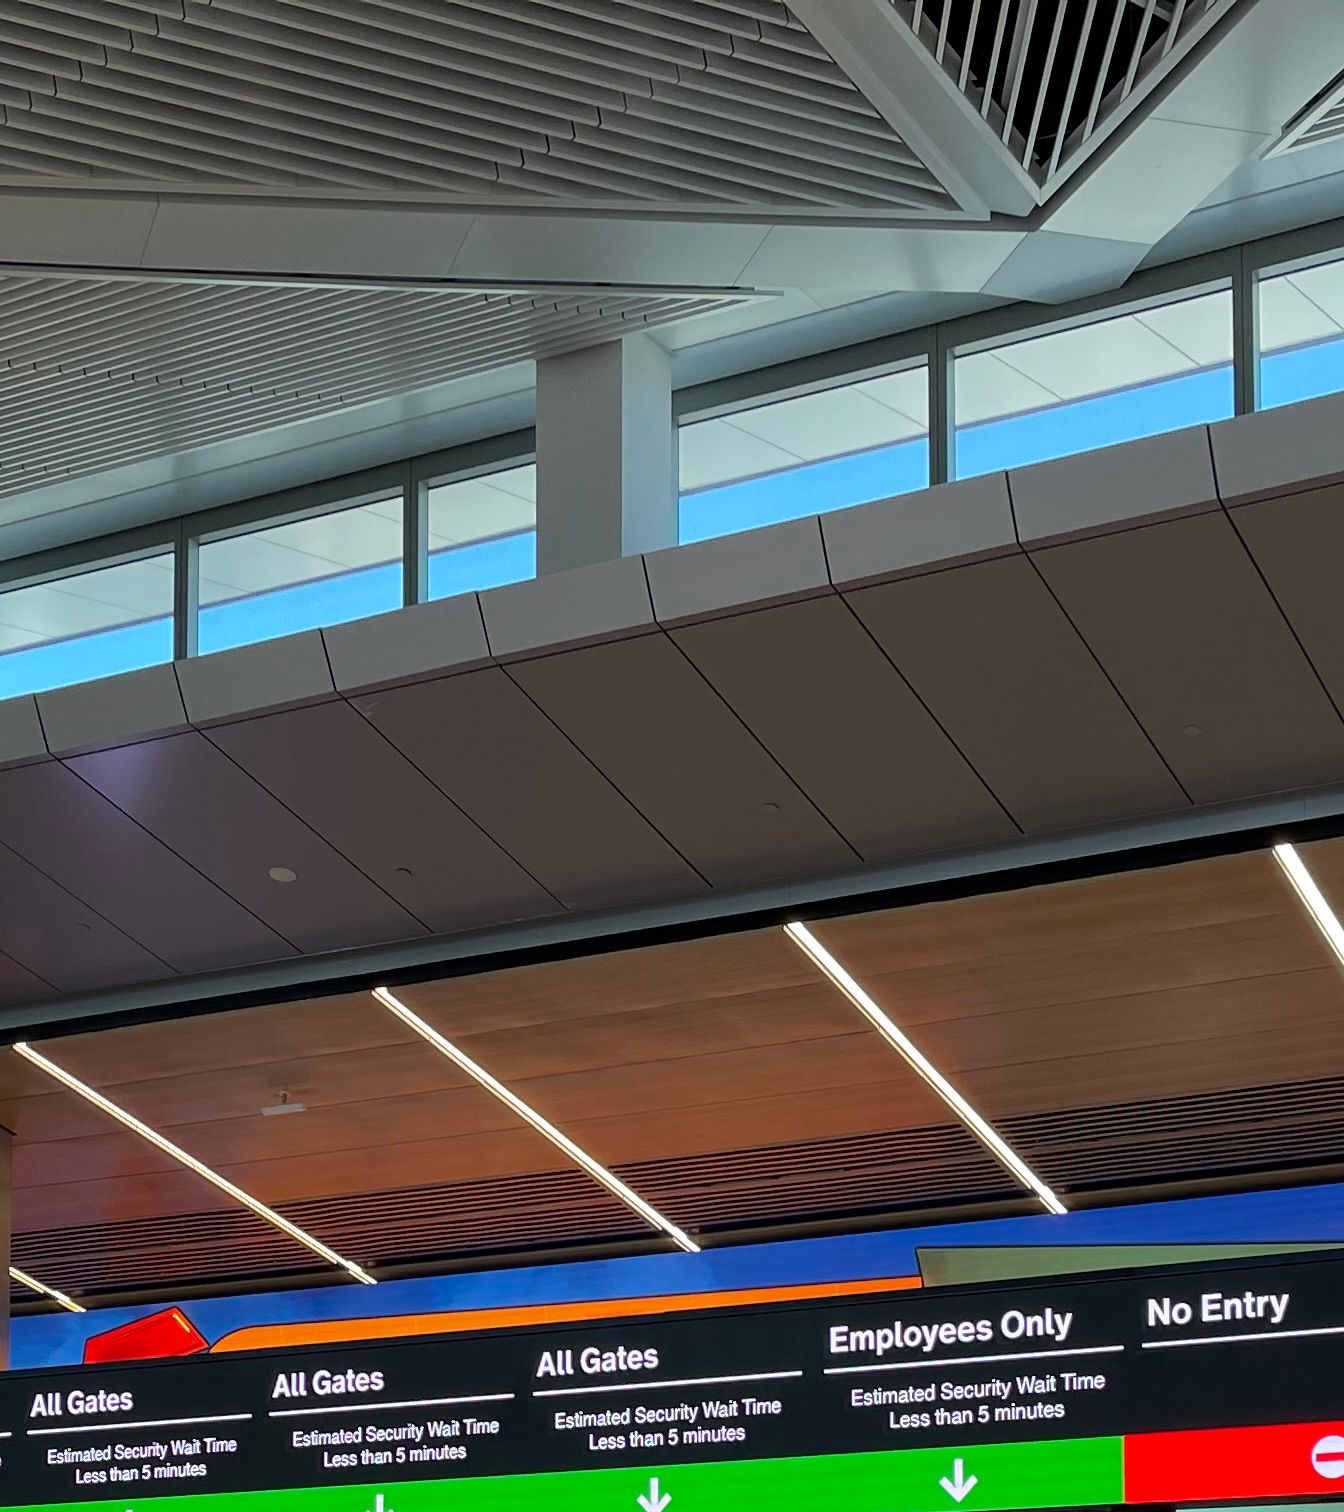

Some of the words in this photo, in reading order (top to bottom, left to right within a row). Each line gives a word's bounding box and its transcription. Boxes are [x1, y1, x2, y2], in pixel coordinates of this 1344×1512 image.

[1148, 1298, 1192, 1326] No
[1201, 1292, 1289, 1323] Entry
[830, 1320, 993, 1356] Employees
[1001, 1308, 1072, 1341] Only
[536, 1350, 574, 1377] All
[580, 1346, 658, 1374] Gates
[272, 1372, 307, 1398] All
[312, 1369, 384, 1395] Gates
[852, 1384, 936, 1406] Estimated
[940, 1379, 1013, 1405] Security
[1016, 1375, 1056, 1394] Wait
[1060, 1373, 1105, 1391] Time
[30, 1393, 62, 1417] All
[67, 1390, 133, 1414] Gates
[555, 1408, 630, 1429] Estimated
[635, 1403, 699, 1428] Security
[702, 1400, 738, 1418] Wait
[741, 1398, 781, 1415] Time
[890, 1412, 930, 1428] Less
[934, 1408, 973, 1425] than
[978, 1405, 990, 1423] 5
[995, 1402, 1065, 1421] minutes
[293, 1427, 362, 1447] Estimated
[366, 1423, 424, 1442] Security
[427, 1420, 460, 1437] Wait
[463, 1418, 499, 1435] Time
[589, 1434, 625, 1450] Less
[629, 1431, 663, 1447] than
[668, 1428, 679, 1445] 5
[683, 1426, 745, 1443] minutes
[47, 1445, 111, 1464] Estimated
[114, 1442, 168, 1464] Security
[170, 1439, 201, 1455] Wait
[203, 1438, 237, 1453] Time
[324, 1452, 357, 1467] Less
[360, 1449, 392, 1465] than
[396, 1447, 406, 1463] 5
[410, 1445, 467, 1461] minutes
[76, 1469, 107, 1484] Less
[110, 1467, 139, 1481] than
[142, 1465, 151, 1479] 5
[154, 1462, 207, 1478] minutes
